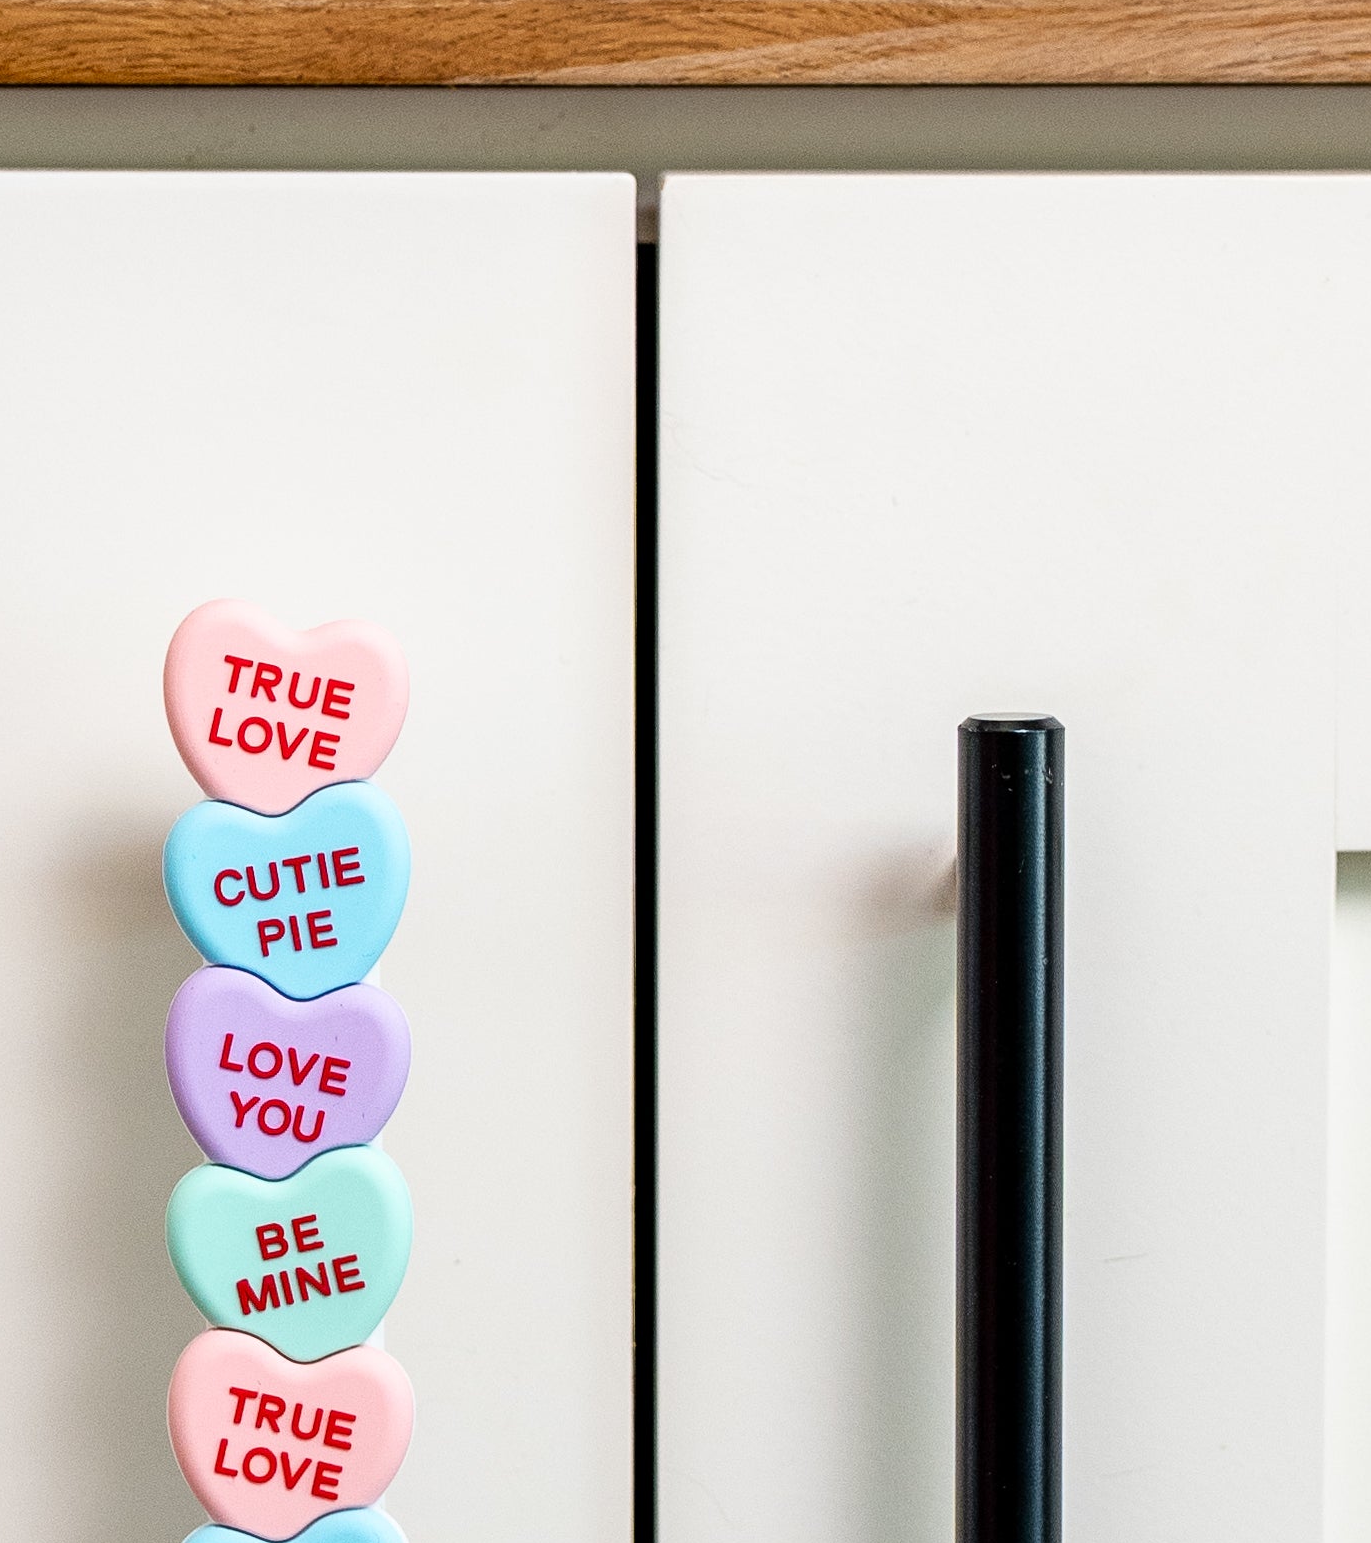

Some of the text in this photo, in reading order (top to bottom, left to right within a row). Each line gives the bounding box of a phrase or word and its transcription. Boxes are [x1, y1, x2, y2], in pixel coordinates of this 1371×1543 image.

[223, 654, 356, 720] TRUE
[208, 707, 341, 771] LOVE
[214, 847, 365, 906] CUTIE
[257, 909, 338, 957] PIE
[218, 1032, 352, 1097] LOVE
[229, 1090, 326, 1144] YOU
[256, 1214, 324, 1260] BE
[236, 1254, 365, 1315] MINE
[228, 1386, 357, 1452] TRUE
[213, 1438, 343, 1502] LOVE
